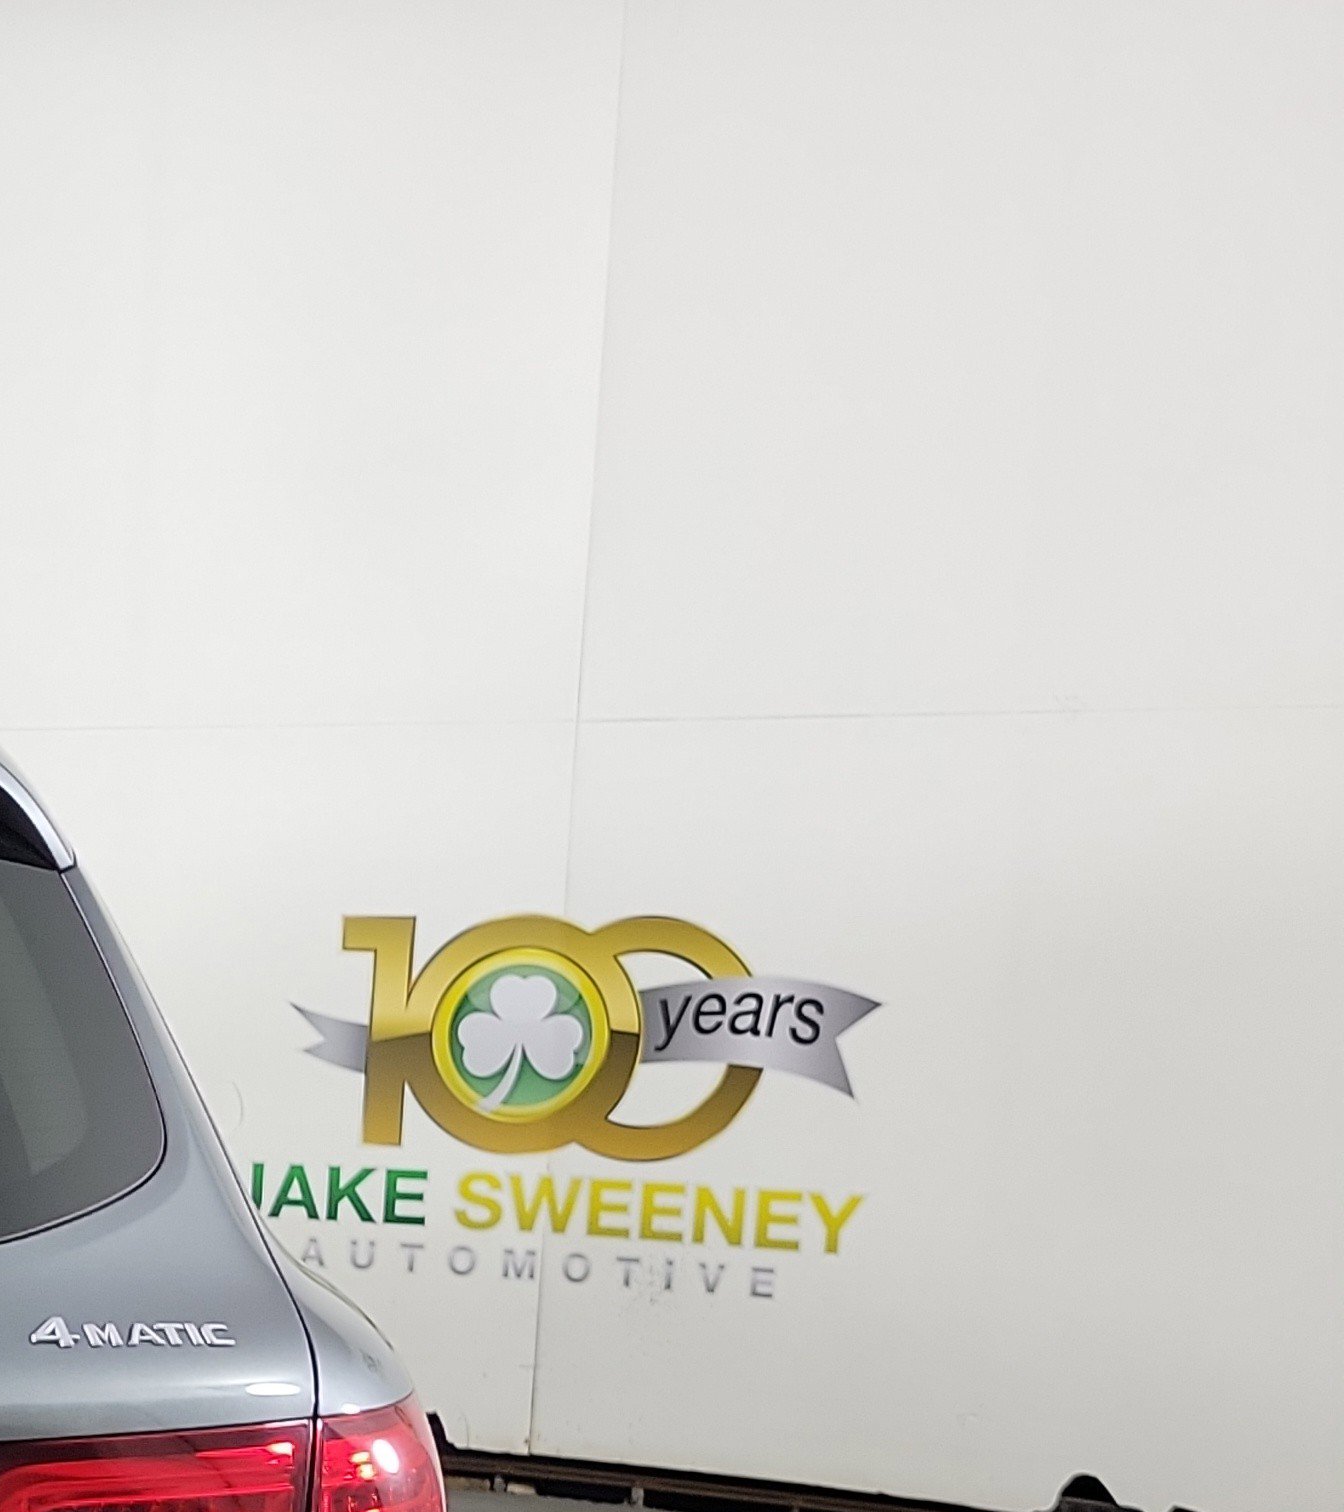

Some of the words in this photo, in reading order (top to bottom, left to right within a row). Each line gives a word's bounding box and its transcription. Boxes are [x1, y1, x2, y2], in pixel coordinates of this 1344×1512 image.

[654, 991, 824, 1052] years
[454, 1170, 864, 1255] SWEENEY
[302, 1238, 777, 1300] AUTOMOTIVE
